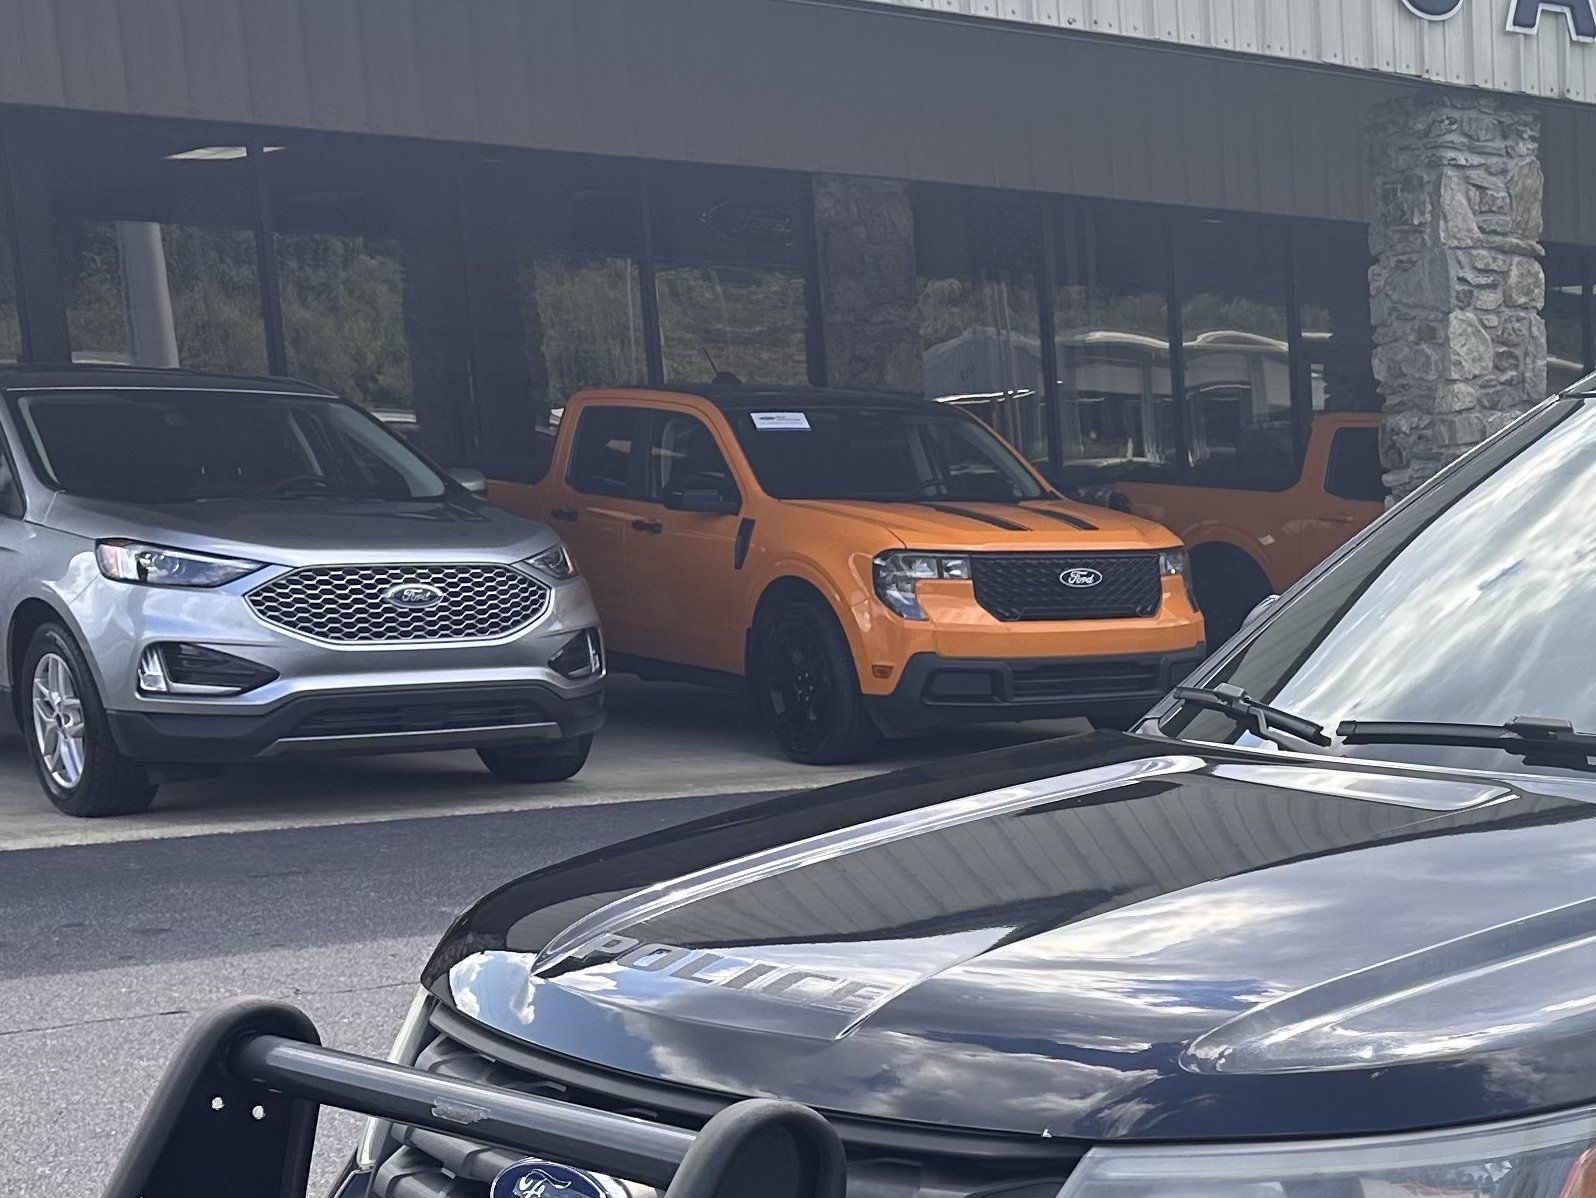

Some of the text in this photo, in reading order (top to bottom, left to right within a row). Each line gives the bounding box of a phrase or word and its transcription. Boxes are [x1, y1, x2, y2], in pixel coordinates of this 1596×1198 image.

[1068, 570, 1095, 584] Ford
[401, 588, 431, 602] Ford
[570, 933, 894, 1014] POLICE
